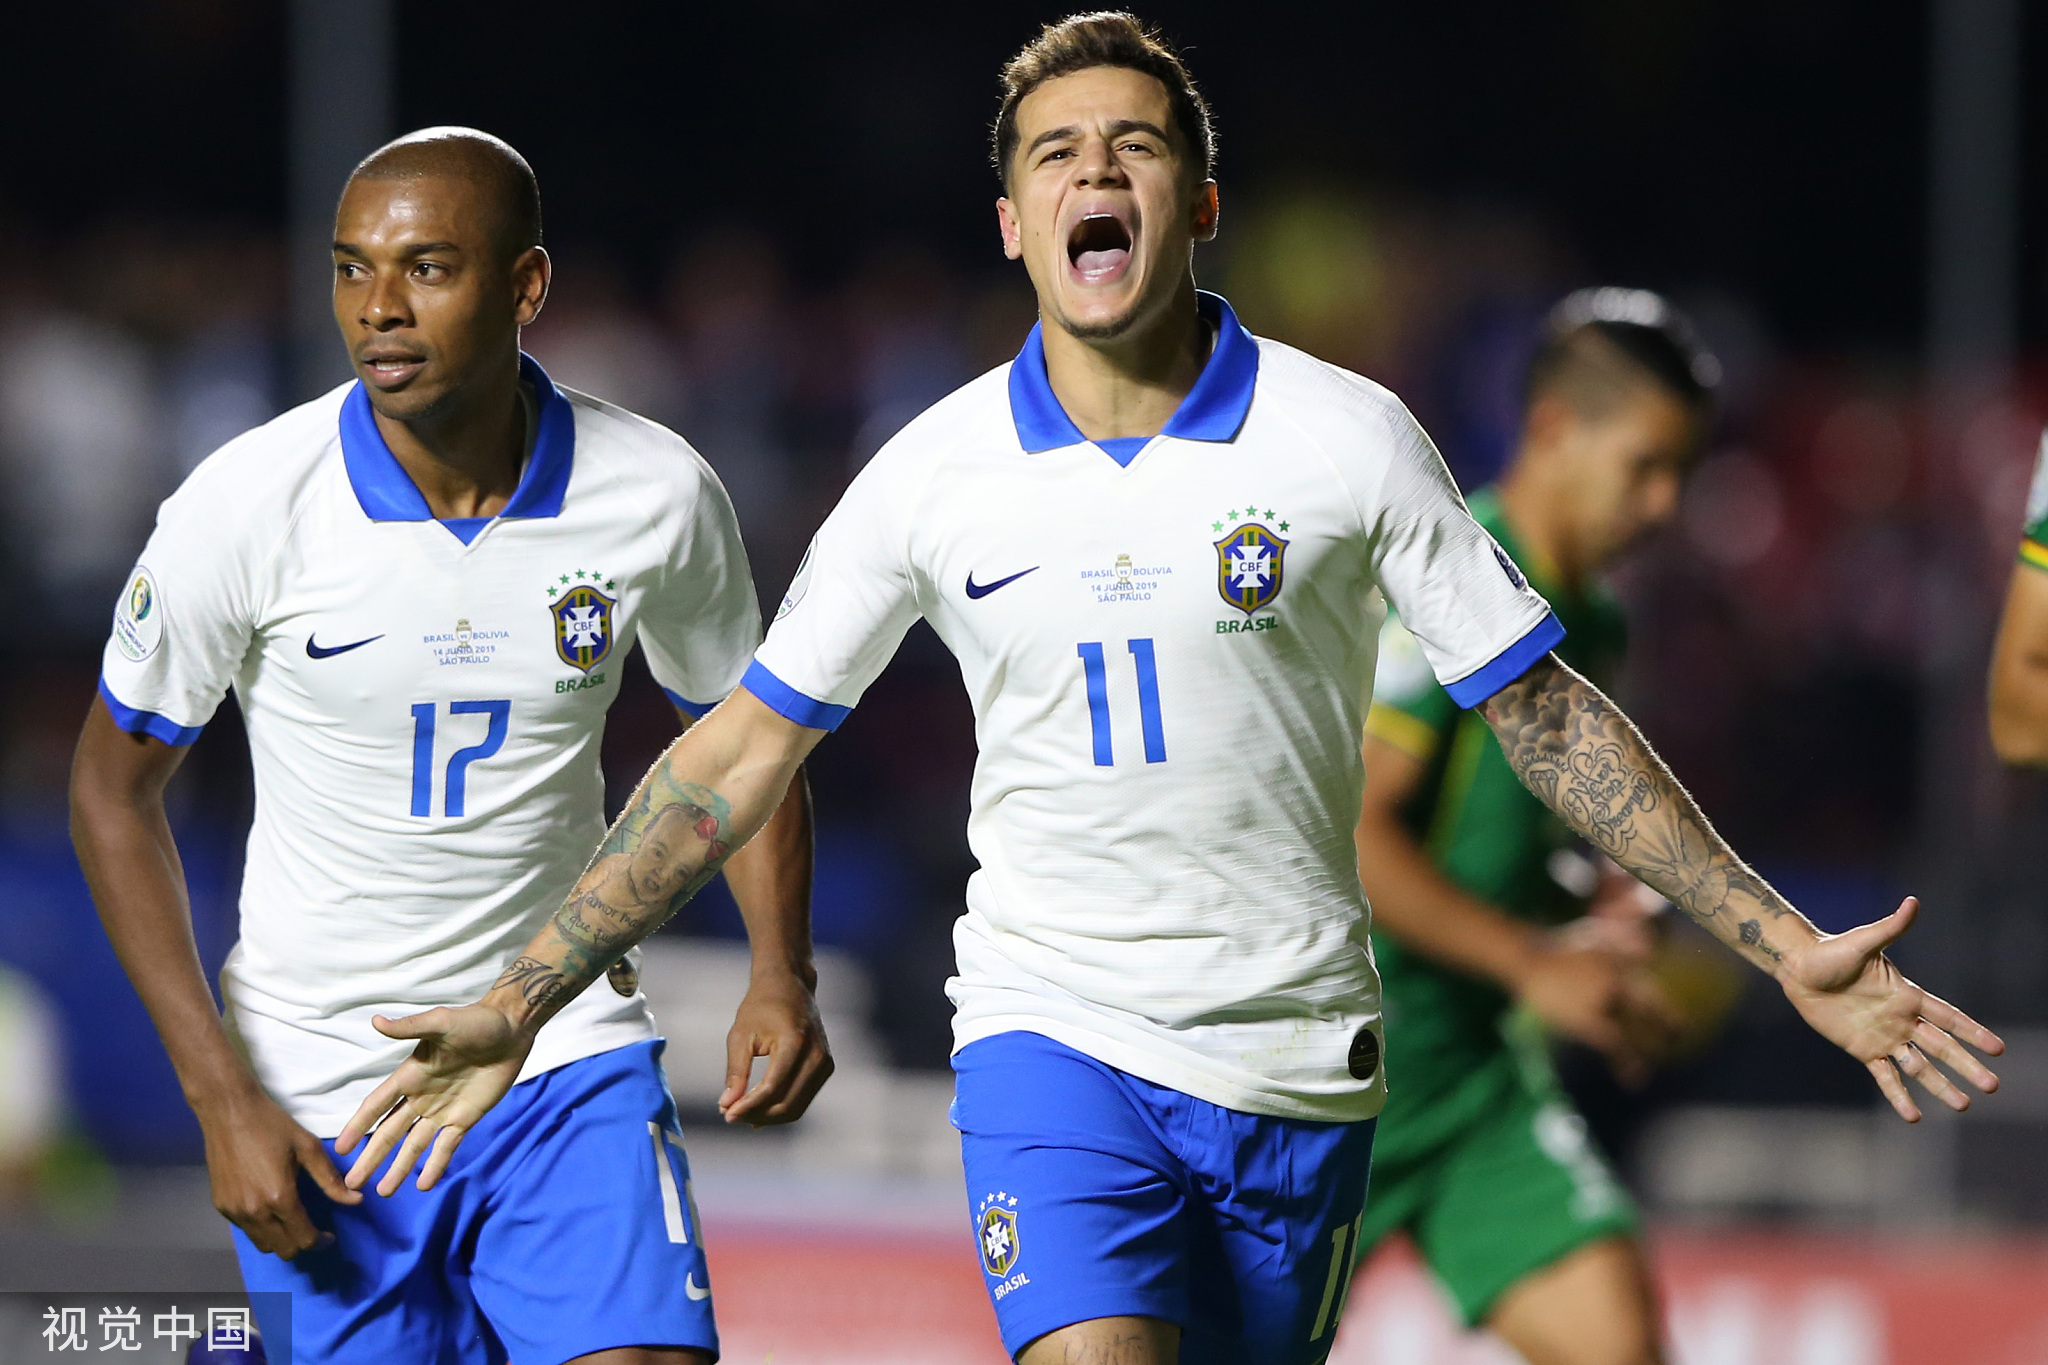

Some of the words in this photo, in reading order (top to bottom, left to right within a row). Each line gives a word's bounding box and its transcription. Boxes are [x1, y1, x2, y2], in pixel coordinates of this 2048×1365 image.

[1239, 561, 1263, 572] CBF
[1081, 570, 1115, 578] BRASIL
[1133, 567, 1172, 576] BOLIVIA
[1091, 584, 1101, 592] 14
[1136, 582, 1157, 590] 2019
[1119, 592, 1151, 601] PAULO
[573, 621, 594, 632] CBF
[1216, 616, 1278, 634] BRASIL
[423, 634, 455, 643] BRASIL
[472, 631, 509, 639] BOLIVIA
[433, 648, 443, 656] 14
[475, 645, 495, 653] 2019
[460, 656, 490, 664] PAULO
[555, 672, 605, 694] BRASIL
[1077, 638, 1167, 767] 11
[410, 699, 512, 818] 17
[990, 1234, 1004, 1247] CBF
[993, 1272, 1030, 1301] BRASIL
